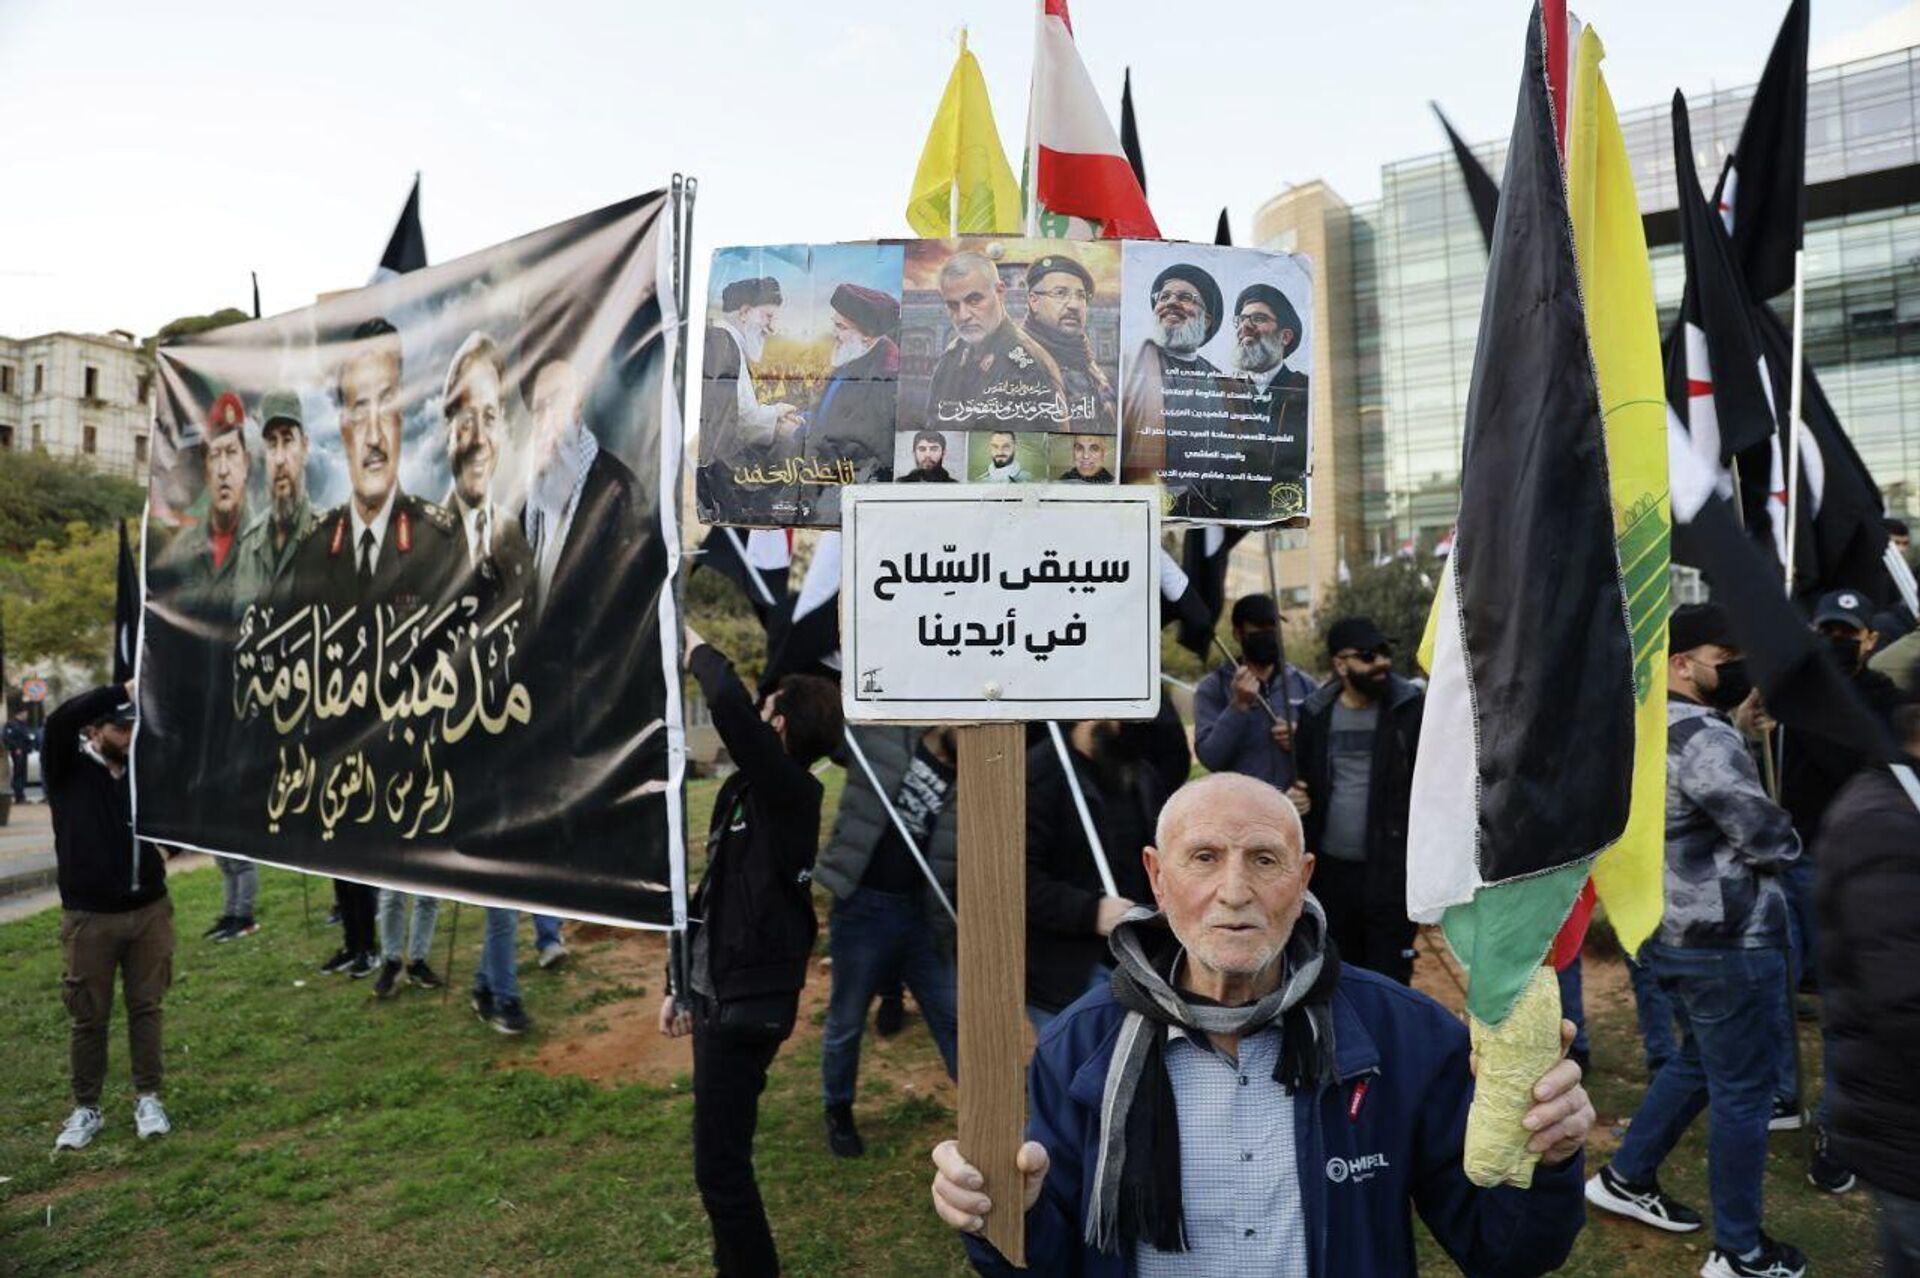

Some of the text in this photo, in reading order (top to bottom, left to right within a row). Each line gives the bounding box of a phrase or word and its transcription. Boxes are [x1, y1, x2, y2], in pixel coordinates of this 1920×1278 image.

[999, 549, 1131, 594] سيبقى
[918, 607, 1088, 662] في أيدينا
